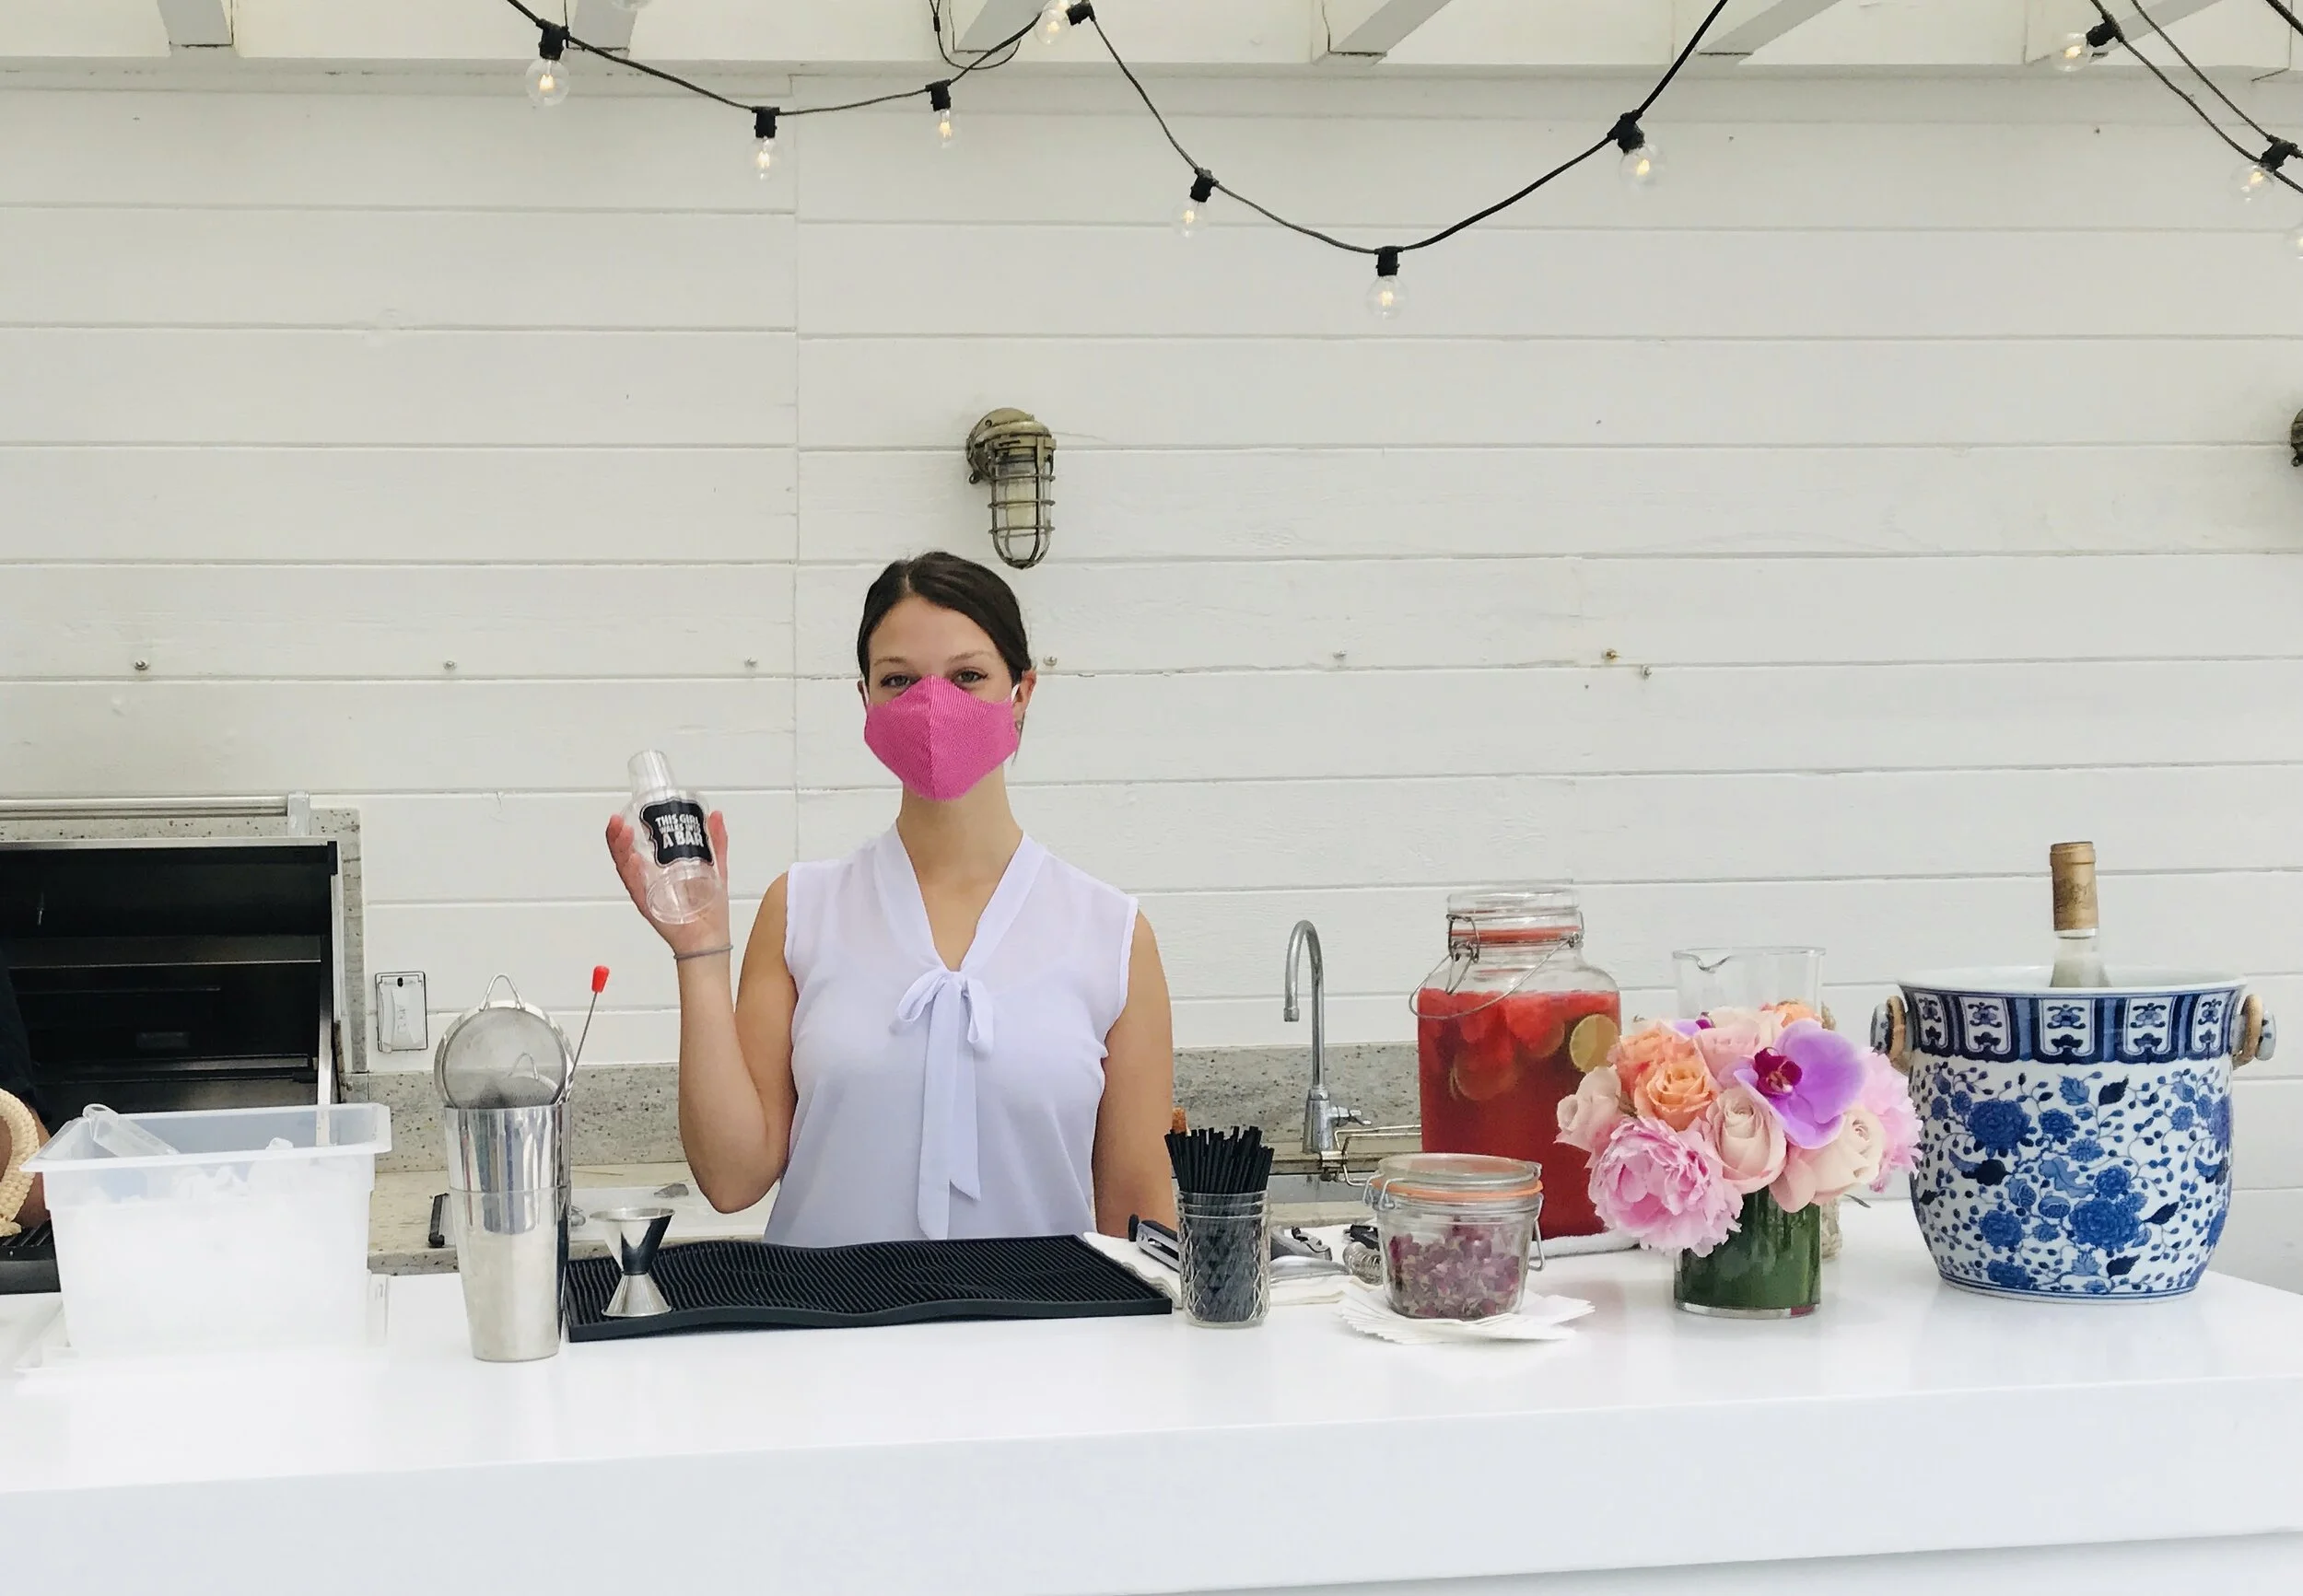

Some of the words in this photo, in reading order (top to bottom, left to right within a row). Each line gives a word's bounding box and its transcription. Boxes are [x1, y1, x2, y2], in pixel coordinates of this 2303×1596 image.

[655, 813, 678, 827] THIS
[679, 813, 699, 825] GIRL
[662, 833, 674, 849] A
[674, 831, 704, 847] BAR
